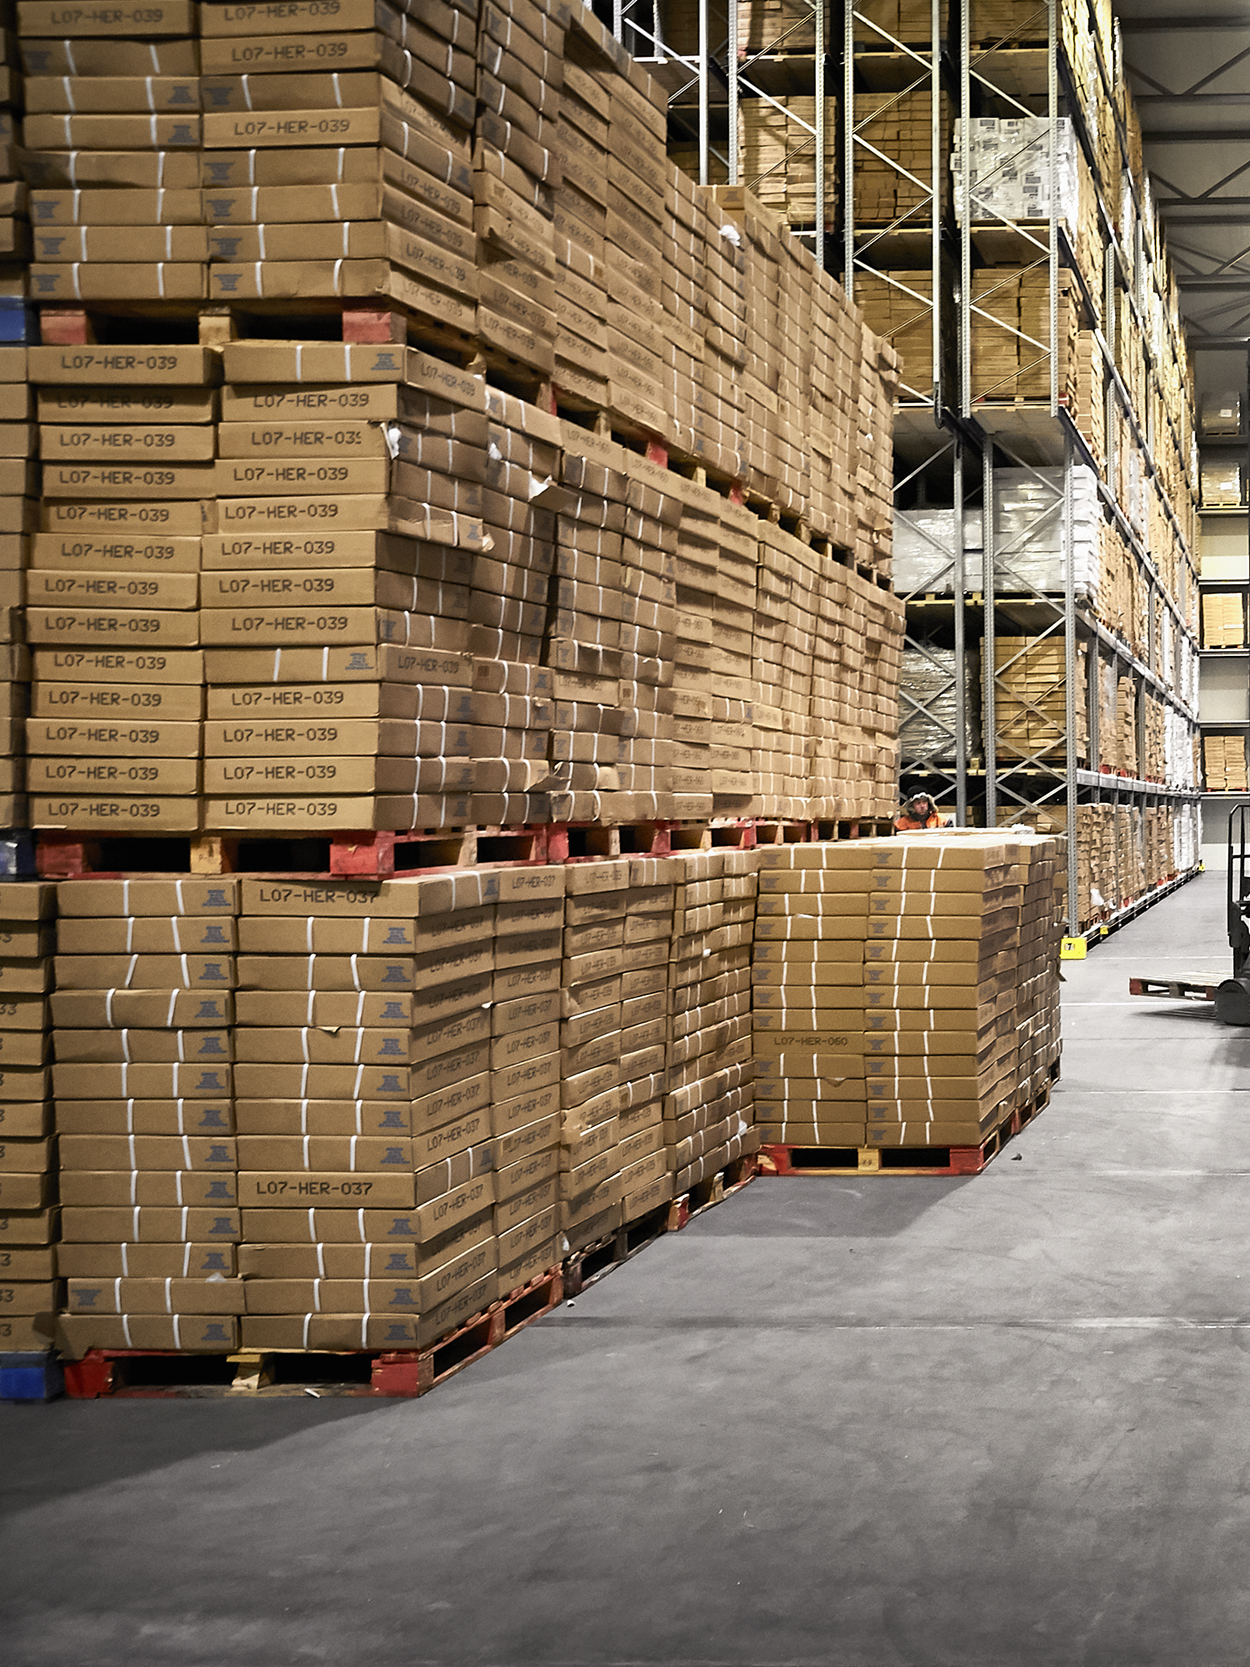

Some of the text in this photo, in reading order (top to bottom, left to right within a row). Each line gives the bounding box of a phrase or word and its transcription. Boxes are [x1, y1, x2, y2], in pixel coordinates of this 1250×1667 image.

[51, 9, 163, 25] L07-HER-039
[231, 42, 348, 63] L07-HER-039
[233, 119, 351, 137] L07-HER-039
[60, 355, 178, 371] L07-HER-039
[253, 392, 370, 409] L07-HER-039
[59, 432, 176, 448] L07-HER-039
[58, 470, 176, 486] L07-HER-039
[233, 466, 349, 482] L07-HER-039
[55, 506, 170, 523] L07-HER-039
[224, 503, 339, 520] L07-HER-039
[60, 543, 175, 560] L07-HER-039
[221, 540, 336, 556] L07-HER-039
[44, 578, 159, 596] L07-HER-039
[218, 577, 335, 594] L07-HER-039
[44, 616, 161, 633] L07-HER-039
[231, 615, 349, 632] L07-HER-039
[53, 653, 167, 671] L07-HER-039
[48, 690, 162, 708] L07-HER-039
[231, 690, 345, 707] L07-HER-039
[45, 726, 160, 744] L07-HER-039
[222, 727, 338, 743] L07-HER-039
[45, 764, 159, 781] L07-HER-039
[223, 764, 337, 781] L07-HER-039
[47, 802, 161, 818] L07-HER-039
[224, 801, 338, 817] L07-HER-039
[259, 888, 378, 904] L07-HER-037
[427, 1016, 480, 1046] L07-HER-037
[773, 1036, 849, 1047] L07-HER-060
[427, 1083, 480, 1117] L07-HER-037
[427, 1118, 480, 1151] L07-HER-037
[255, 1180, 374, 1196] L07-HER-037
[433, 1181, 484, 1222] L07-HER-037
[437, 1251, 486, 1292] L07-HER-037
[435, 1284, 487, 1326] L07-HER-037
